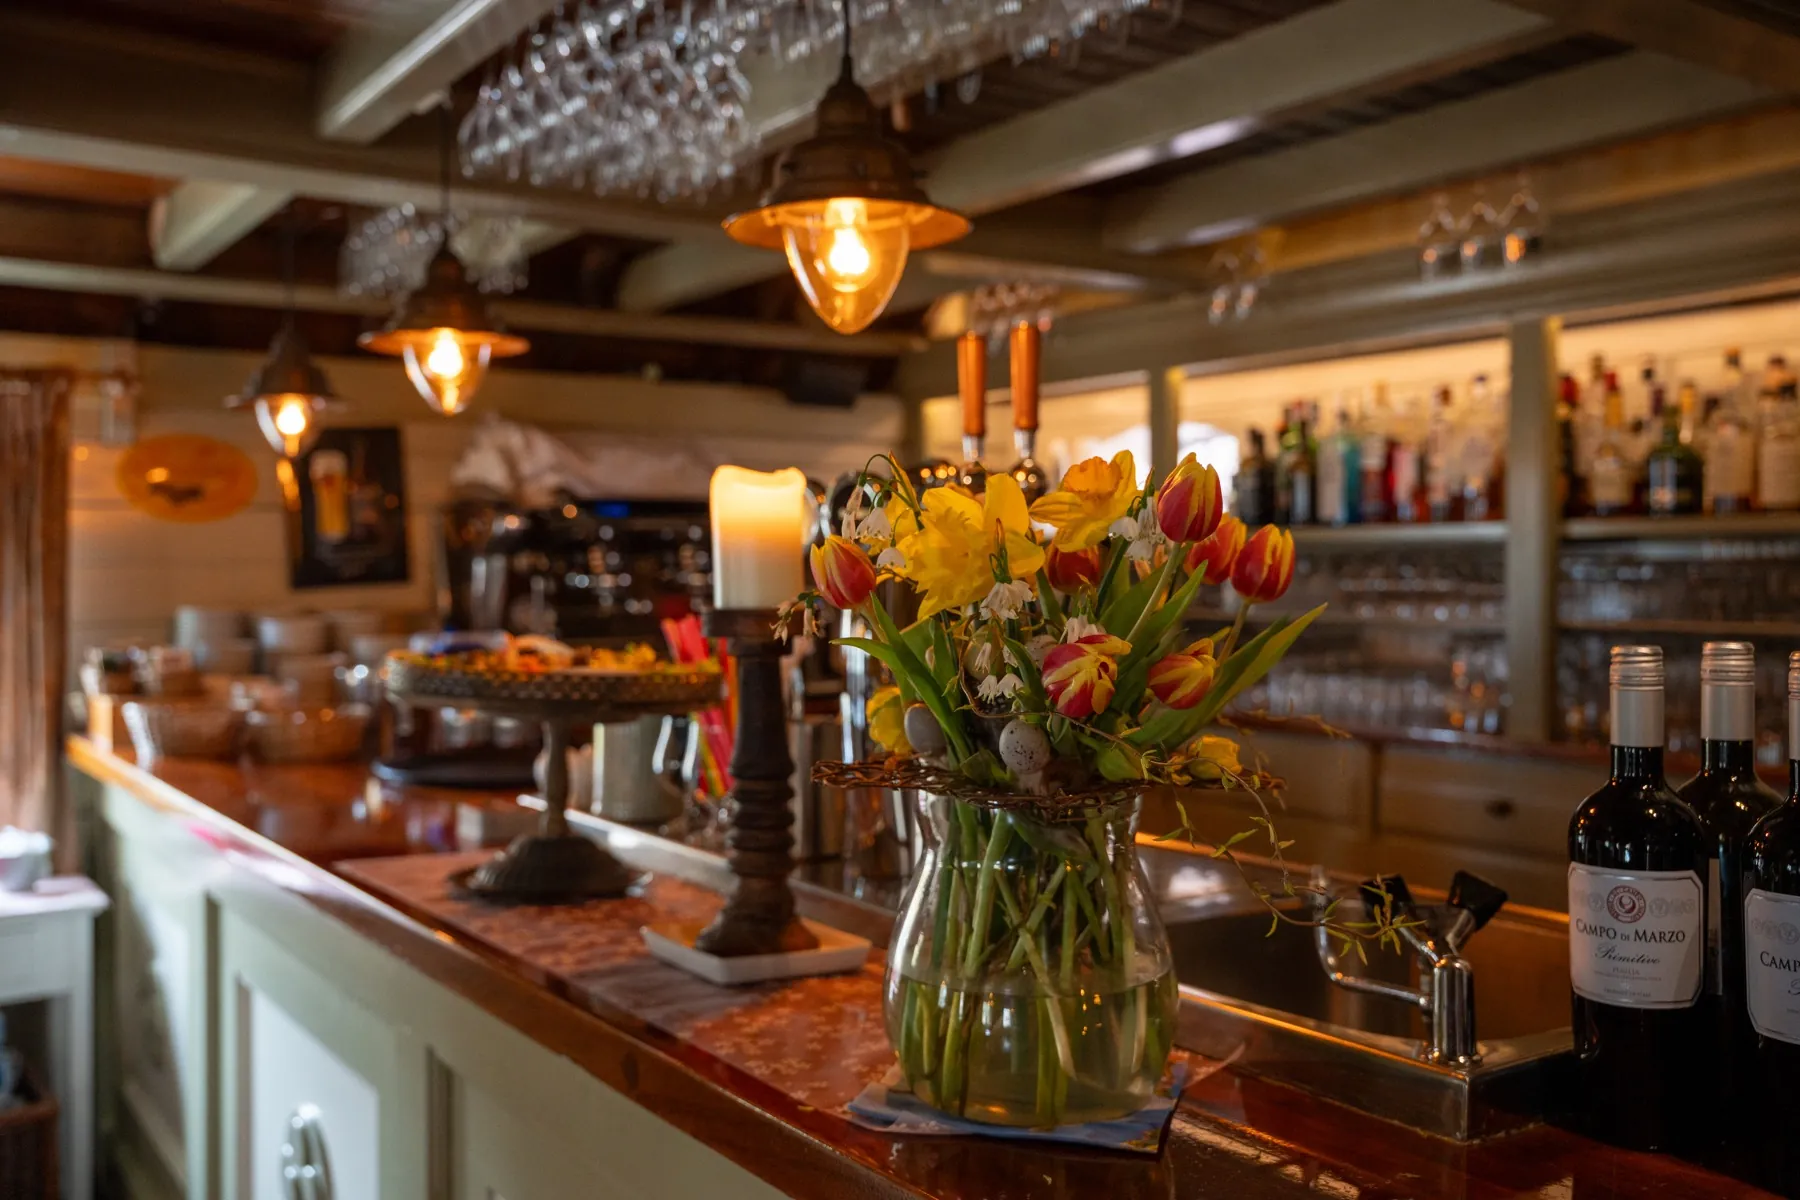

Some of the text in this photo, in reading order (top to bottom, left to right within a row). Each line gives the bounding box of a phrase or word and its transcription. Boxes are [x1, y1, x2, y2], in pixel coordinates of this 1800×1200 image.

[1576, 918, 1617, 940] CAMPO
[1633, 928, 1686, 943] MARZO
[1595, 942, 1660, 965] Primitivo
